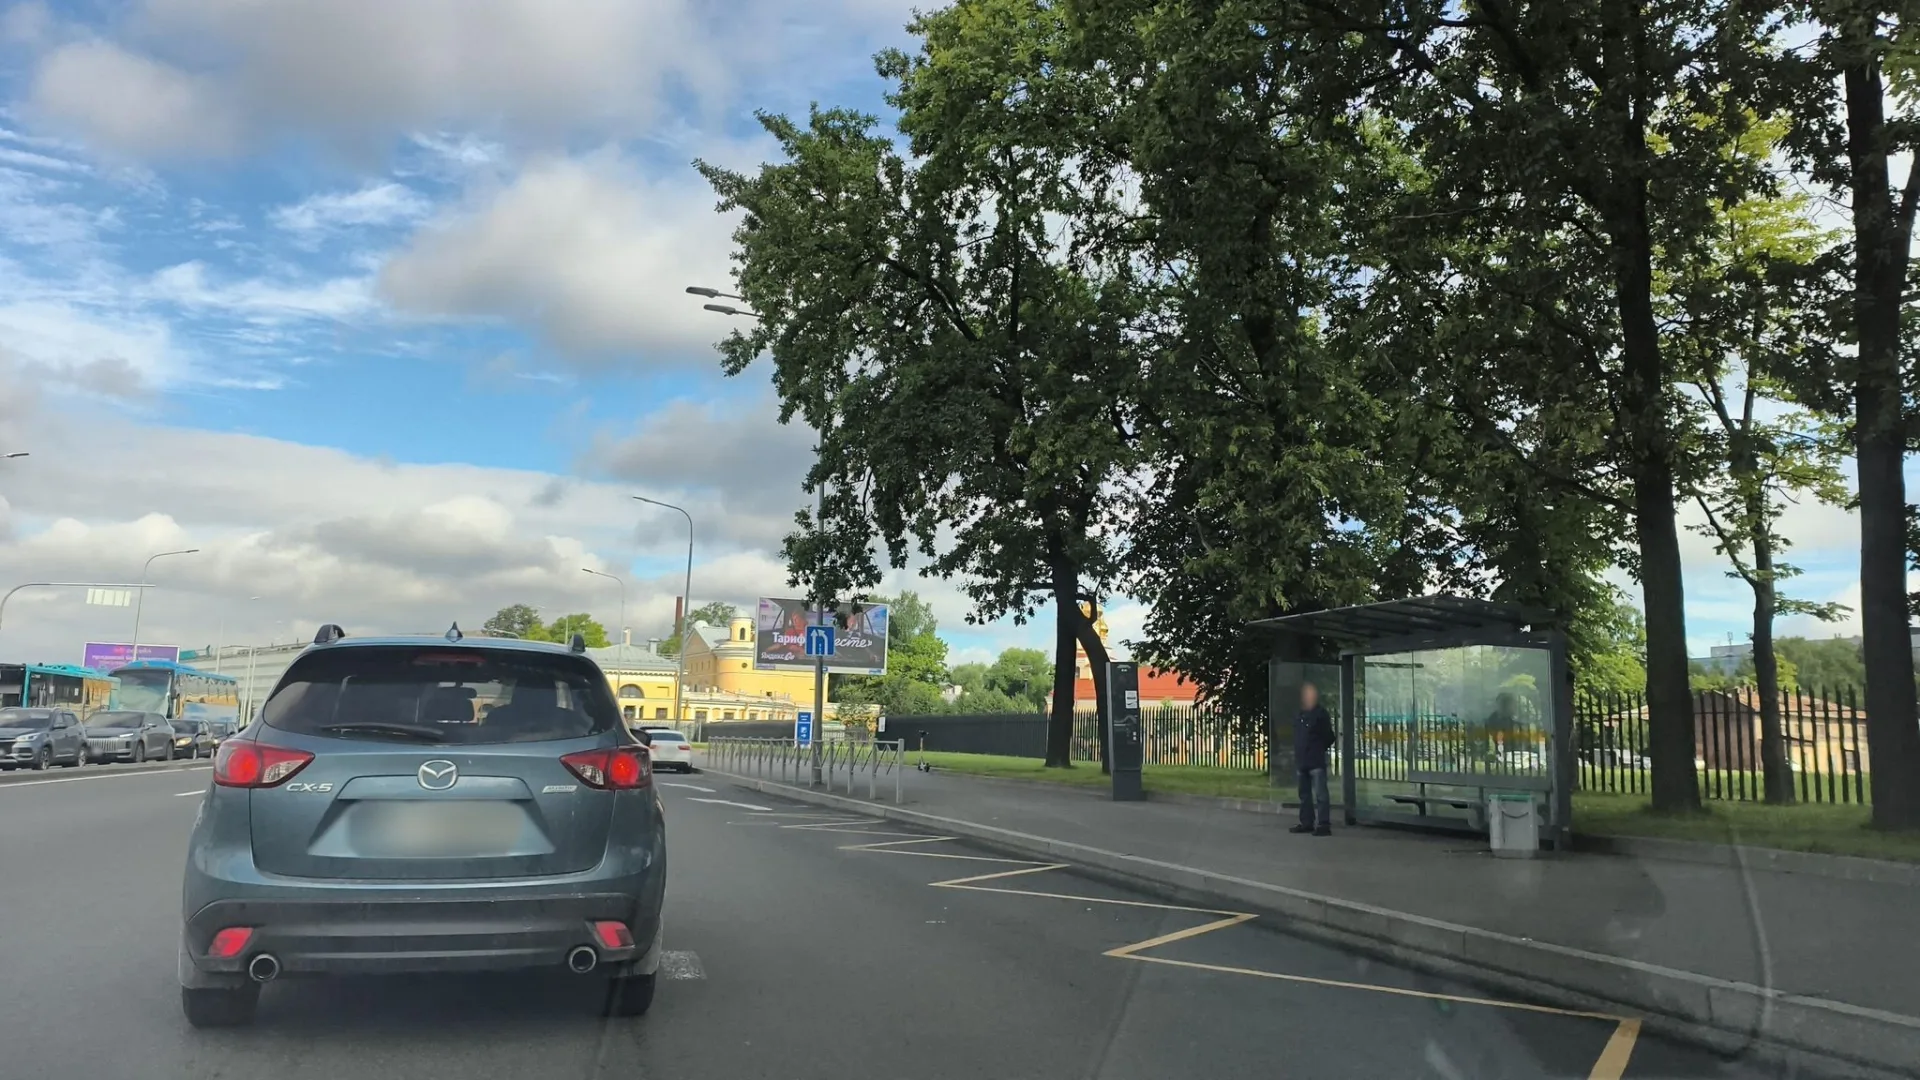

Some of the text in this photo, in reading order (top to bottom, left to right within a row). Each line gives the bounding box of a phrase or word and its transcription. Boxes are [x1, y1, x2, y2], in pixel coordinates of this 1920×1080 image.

[773, 632, 872, 648] Тариф есте»
[286, 783, 333, 793] CX-5
